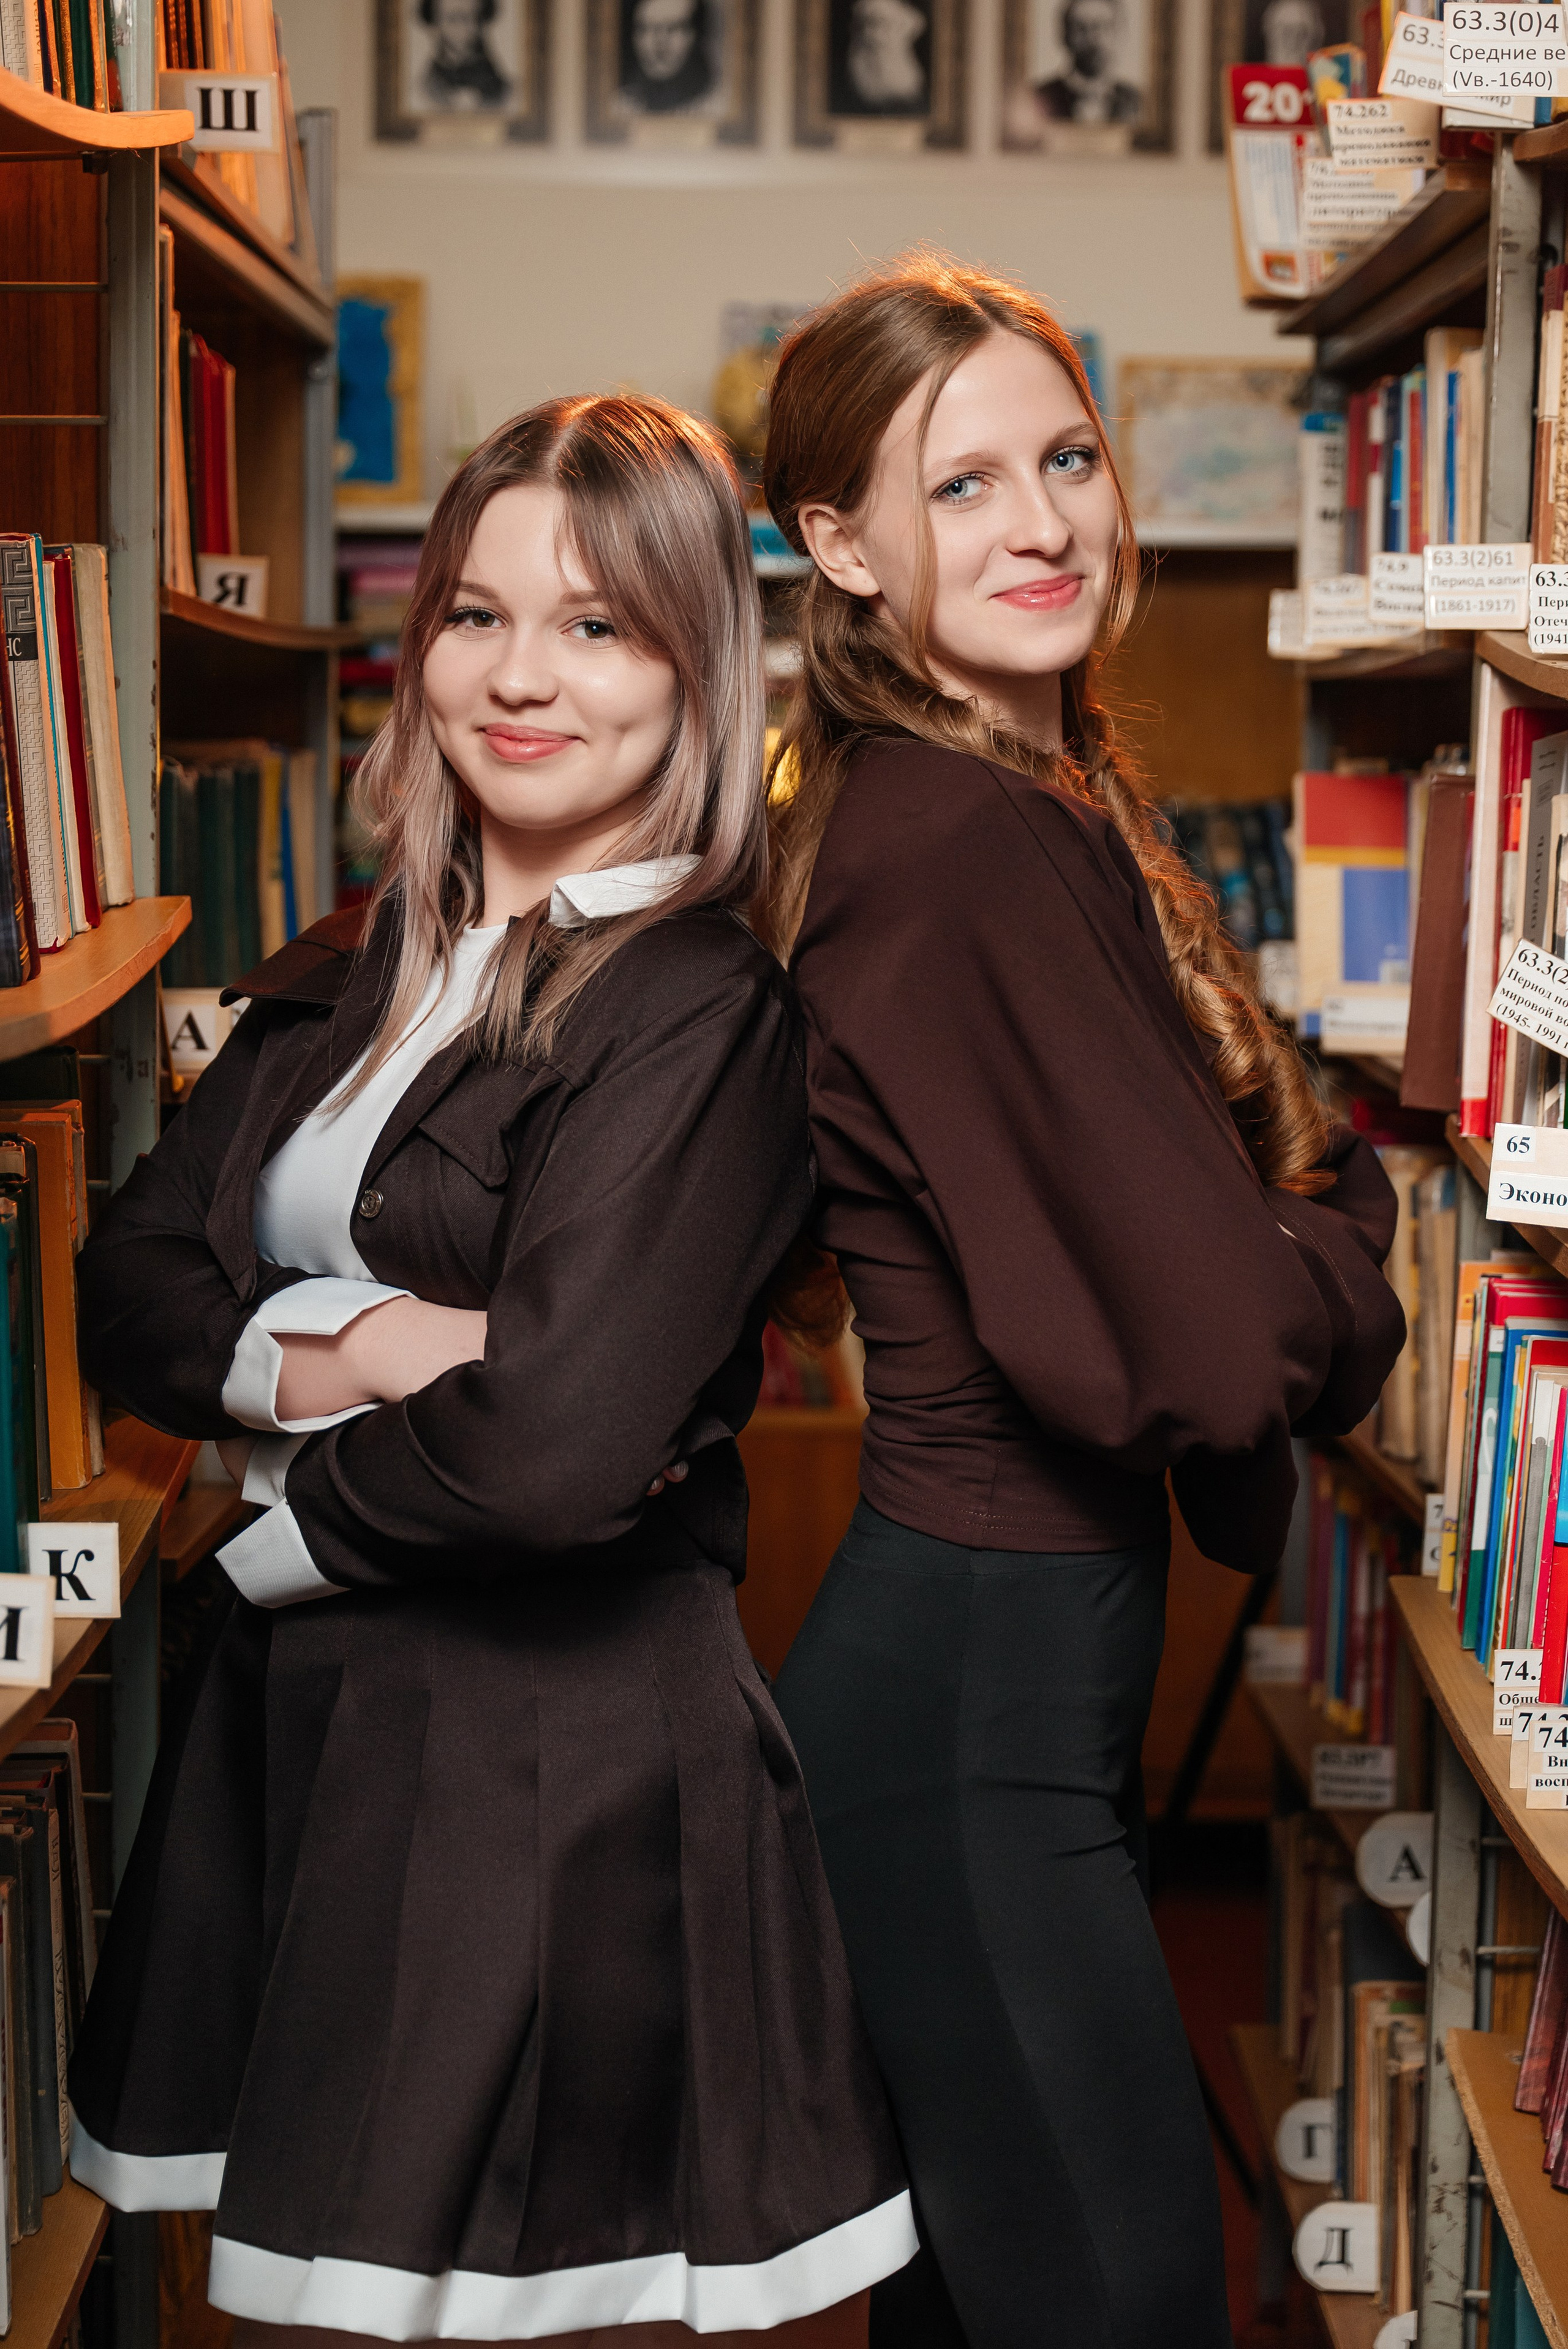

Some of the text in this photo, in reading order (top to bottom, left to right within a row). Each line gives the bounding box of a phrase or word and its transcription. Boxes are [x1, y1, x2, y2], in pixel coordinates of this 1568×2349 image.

[1452, 10, 1559, 37] 63.3(0)4
[1449, 45, 1537, 63] Средние
[198, 88, 261, 131] Ш
[1433, 551, 1514, 568] 63.3(2)61
[214, 572, 247, 606] Я
[1431, 576, 1485, 588] Период
[1435, 599, 1515, 613] (1861-1917)
[1507, 968, 1552, 1000] Период
[1518, 949, 1568, 990] 63.3(2
[1500, 987, 1553, 1019] мировой
[172, 1011, 209, 1050] А
[1536, 1024, 1562, 1044] 1991
[1507, 1136, 1531, 1153] 65
[1499, 1182, 1568, 1206] Эконо
[42, 1549, 96, 1601] К
[1501, 1661, 1543, 1680] 74.
[1389, 1846, 1427, 1882] А
[1314, 2228, 1354, 2274] Д
